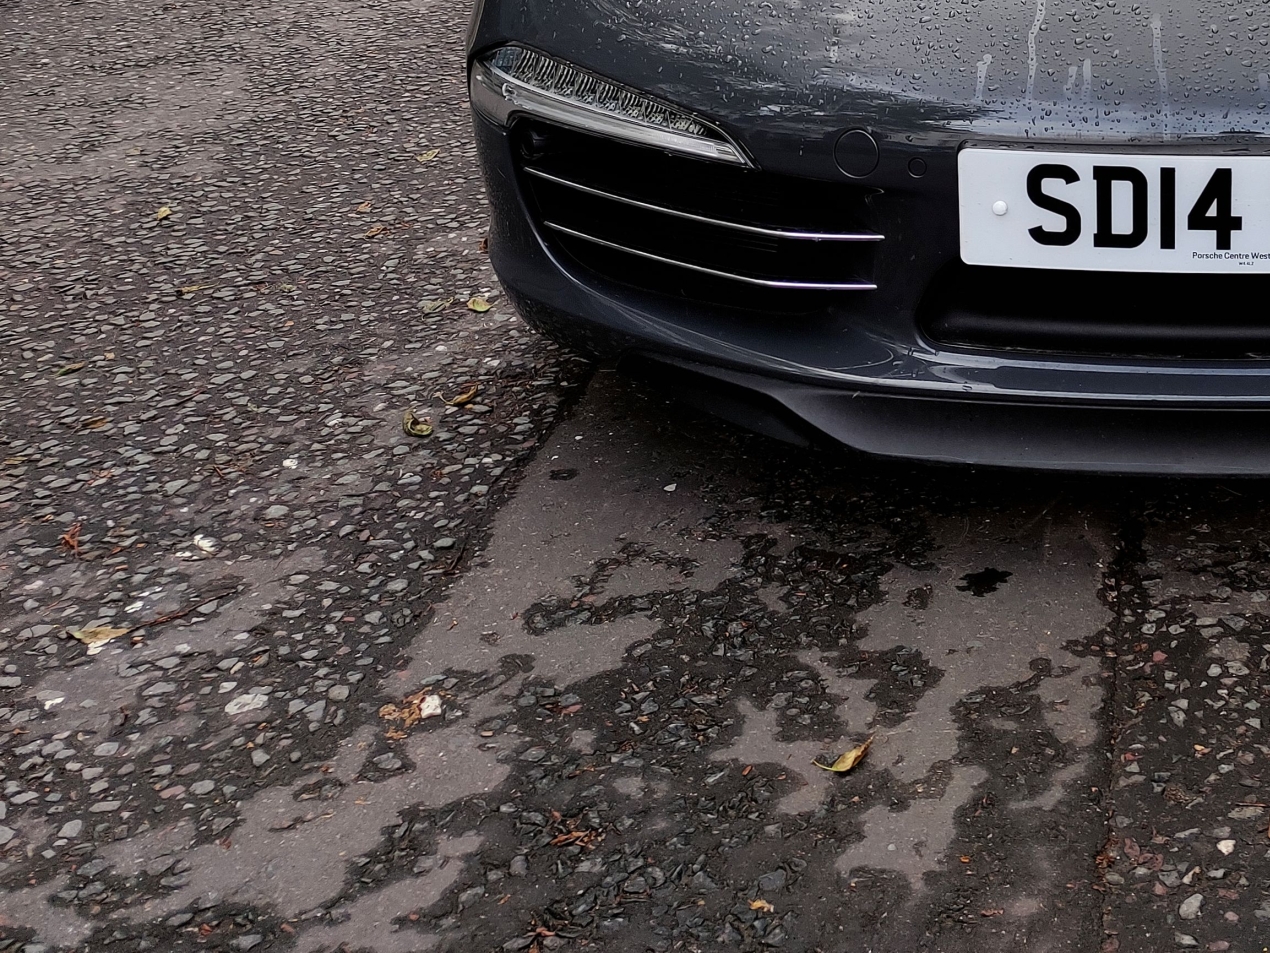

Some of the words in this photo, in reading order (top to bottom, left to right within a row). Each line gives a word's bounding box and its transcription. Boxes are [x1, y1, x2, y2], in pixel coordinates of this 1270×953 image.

[1026, 163, 1242, 250] SD14
[1192, 251, 1223, 260] Porsche
[1224, 251, 1250, 260] Centre
